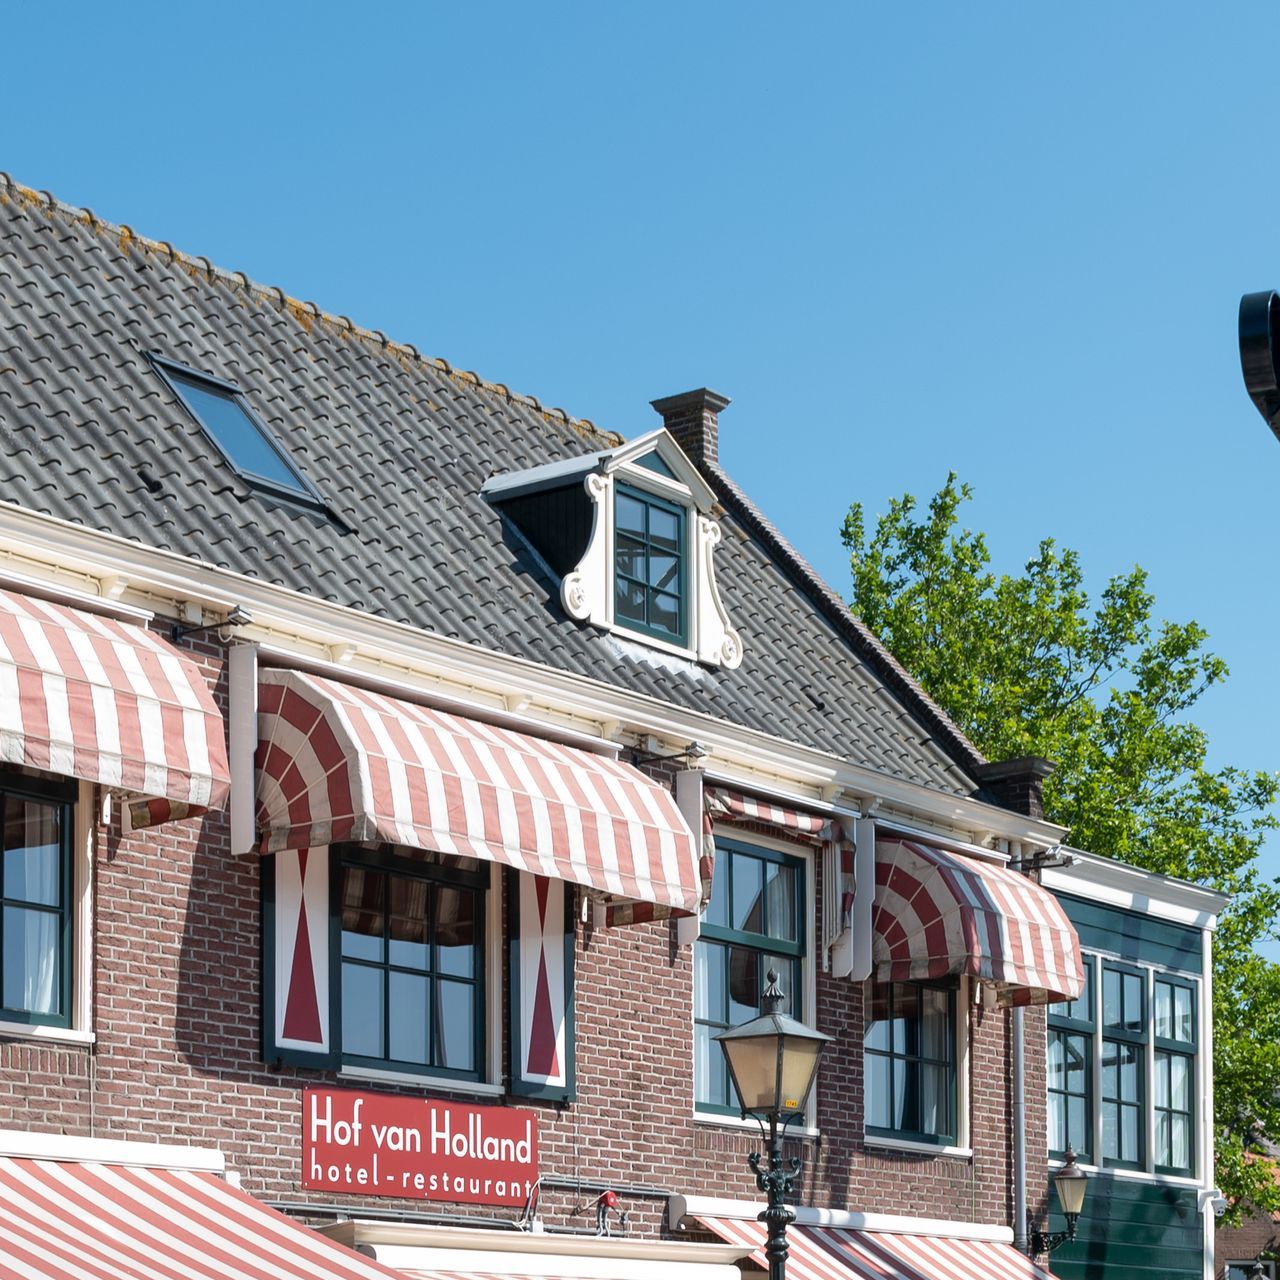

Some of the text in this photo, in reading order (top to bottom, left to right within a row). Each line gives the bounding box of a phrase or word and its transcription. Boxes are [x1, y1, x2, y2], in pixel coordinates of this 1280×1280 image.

[311, 1094, 531, 1163] Hof van Holland
